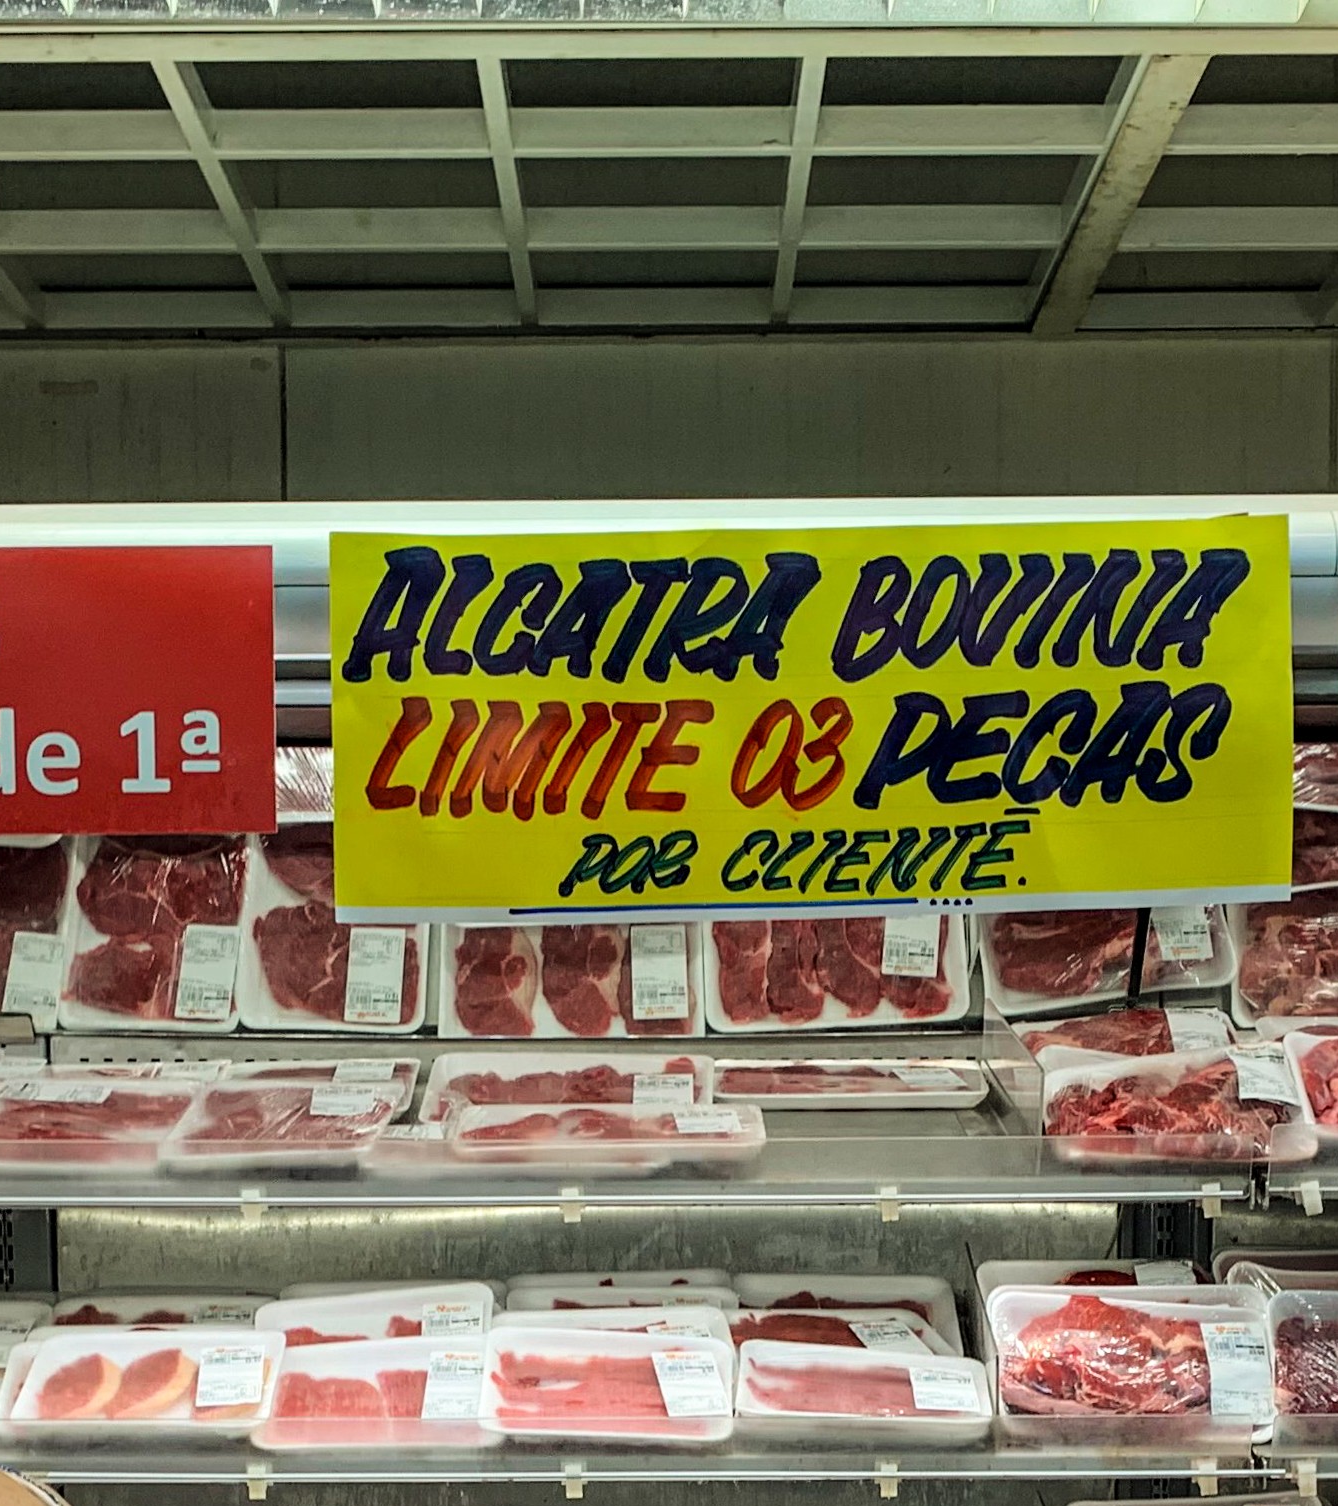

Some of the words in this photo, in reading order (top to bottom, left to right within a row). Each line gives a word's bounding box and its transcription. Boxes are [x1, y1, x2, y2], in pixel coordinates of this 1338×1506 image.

[341, 546, 822, 685] ALCATRA
[830, 547, 1252, 684] BOVINA
[120, 708, 222, 794] 1ª
[364, 696, 716, 822] LIMITE
[730, 696, 853, 812] 03
[557, 829, 700, 898] POR
